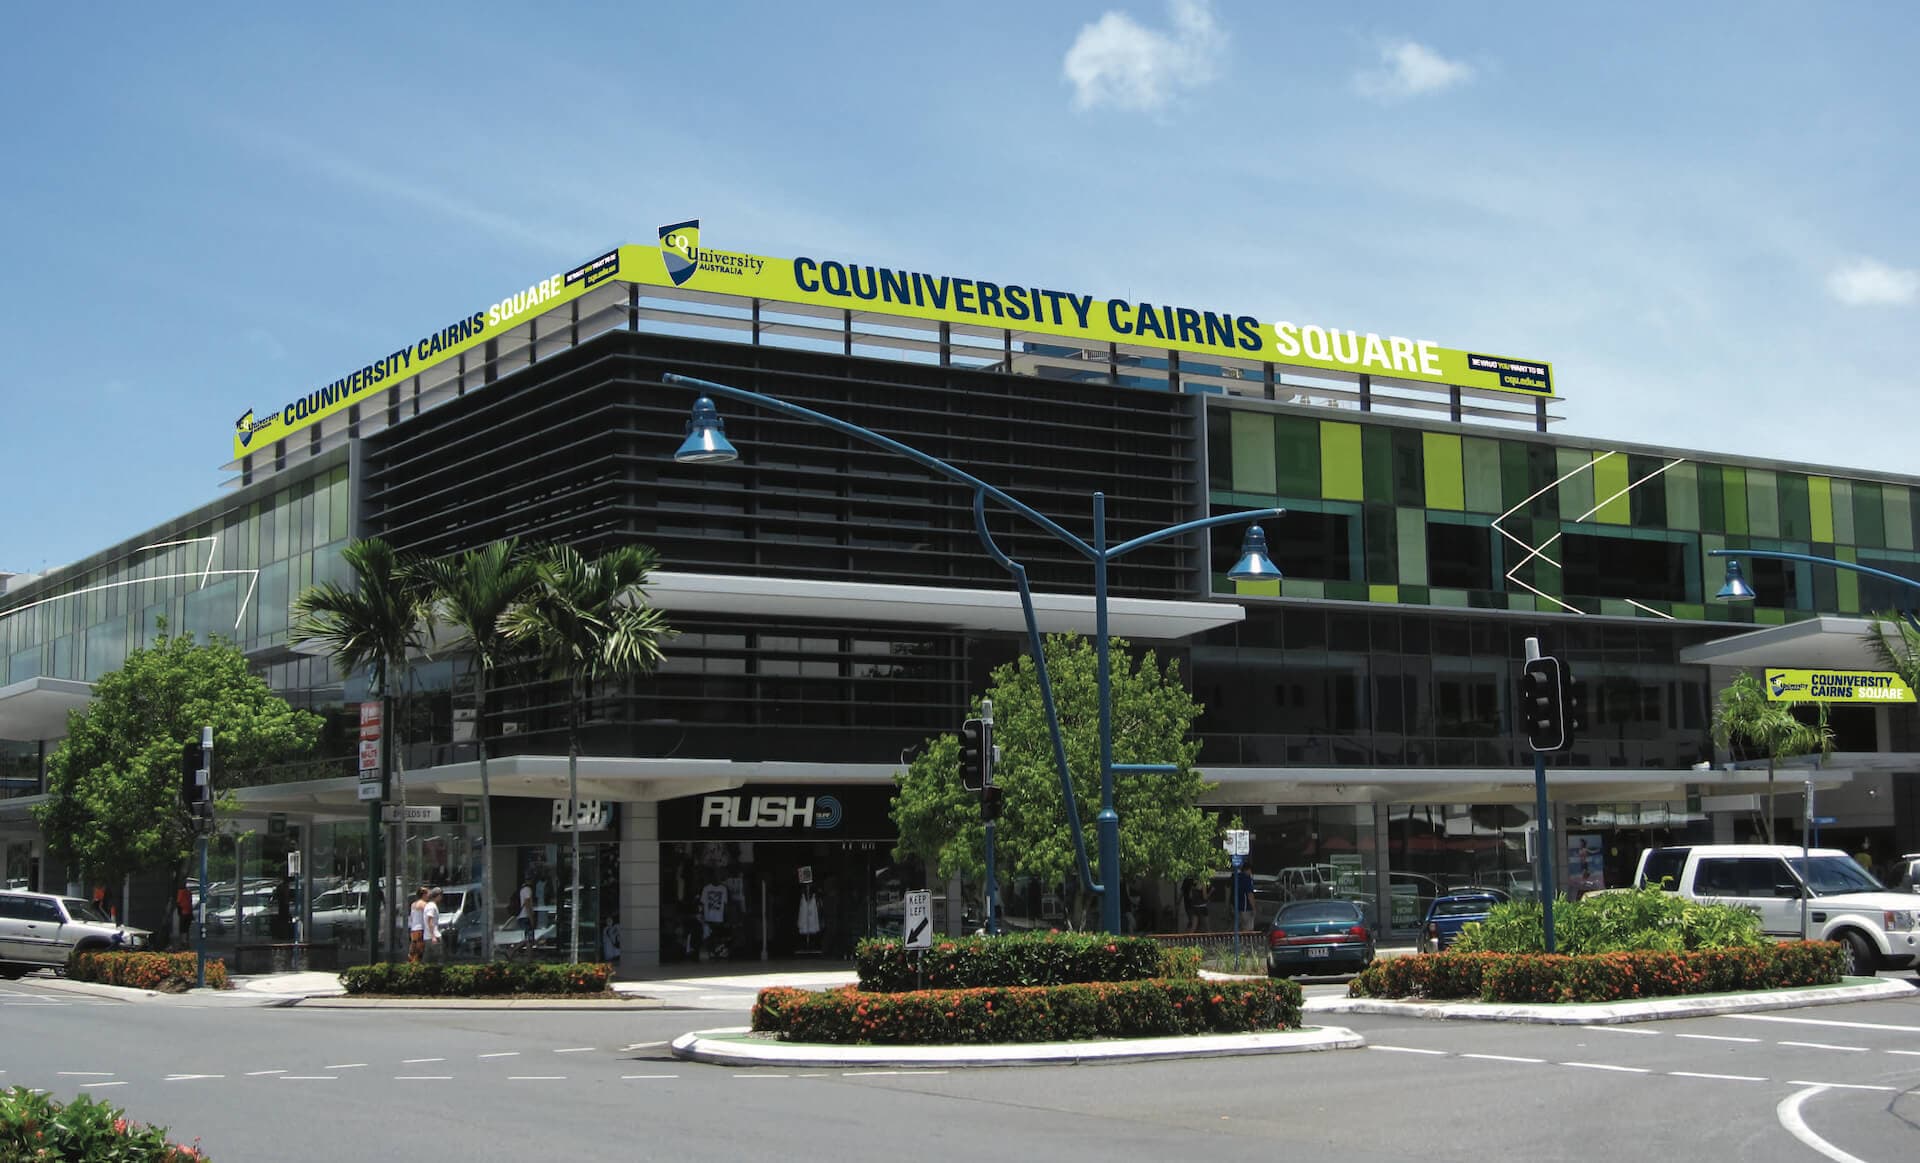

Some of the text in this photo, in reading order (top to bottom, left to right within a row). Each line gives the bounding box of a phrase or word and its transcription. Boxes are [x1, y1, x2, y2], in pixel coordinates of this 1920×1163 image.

[699, 263, 743, 276] AUSTRALIA
[793, 256, 1443, 377] CQUNIVERSITY CAIRNS SQUARE
[283, 273, 562, 426] CQUNIVERSITY CAIRNS SQUARE
[1498, 362, 1511, 371] YOU
[1510, 364, 1528, 373] WANT
[1536, 367, 1545, 375] BE
[1811, 674, 1893, 688] CQUNIVERSITY
[1811, 686, 1904, 699] CAIRNS SQUARE
[423, 809, 431, 818] ST
[700, 796, 815, 828] RUSH
[909, 894, 927, 905] KEEP
[909, 907, 926, 917] LEFT
